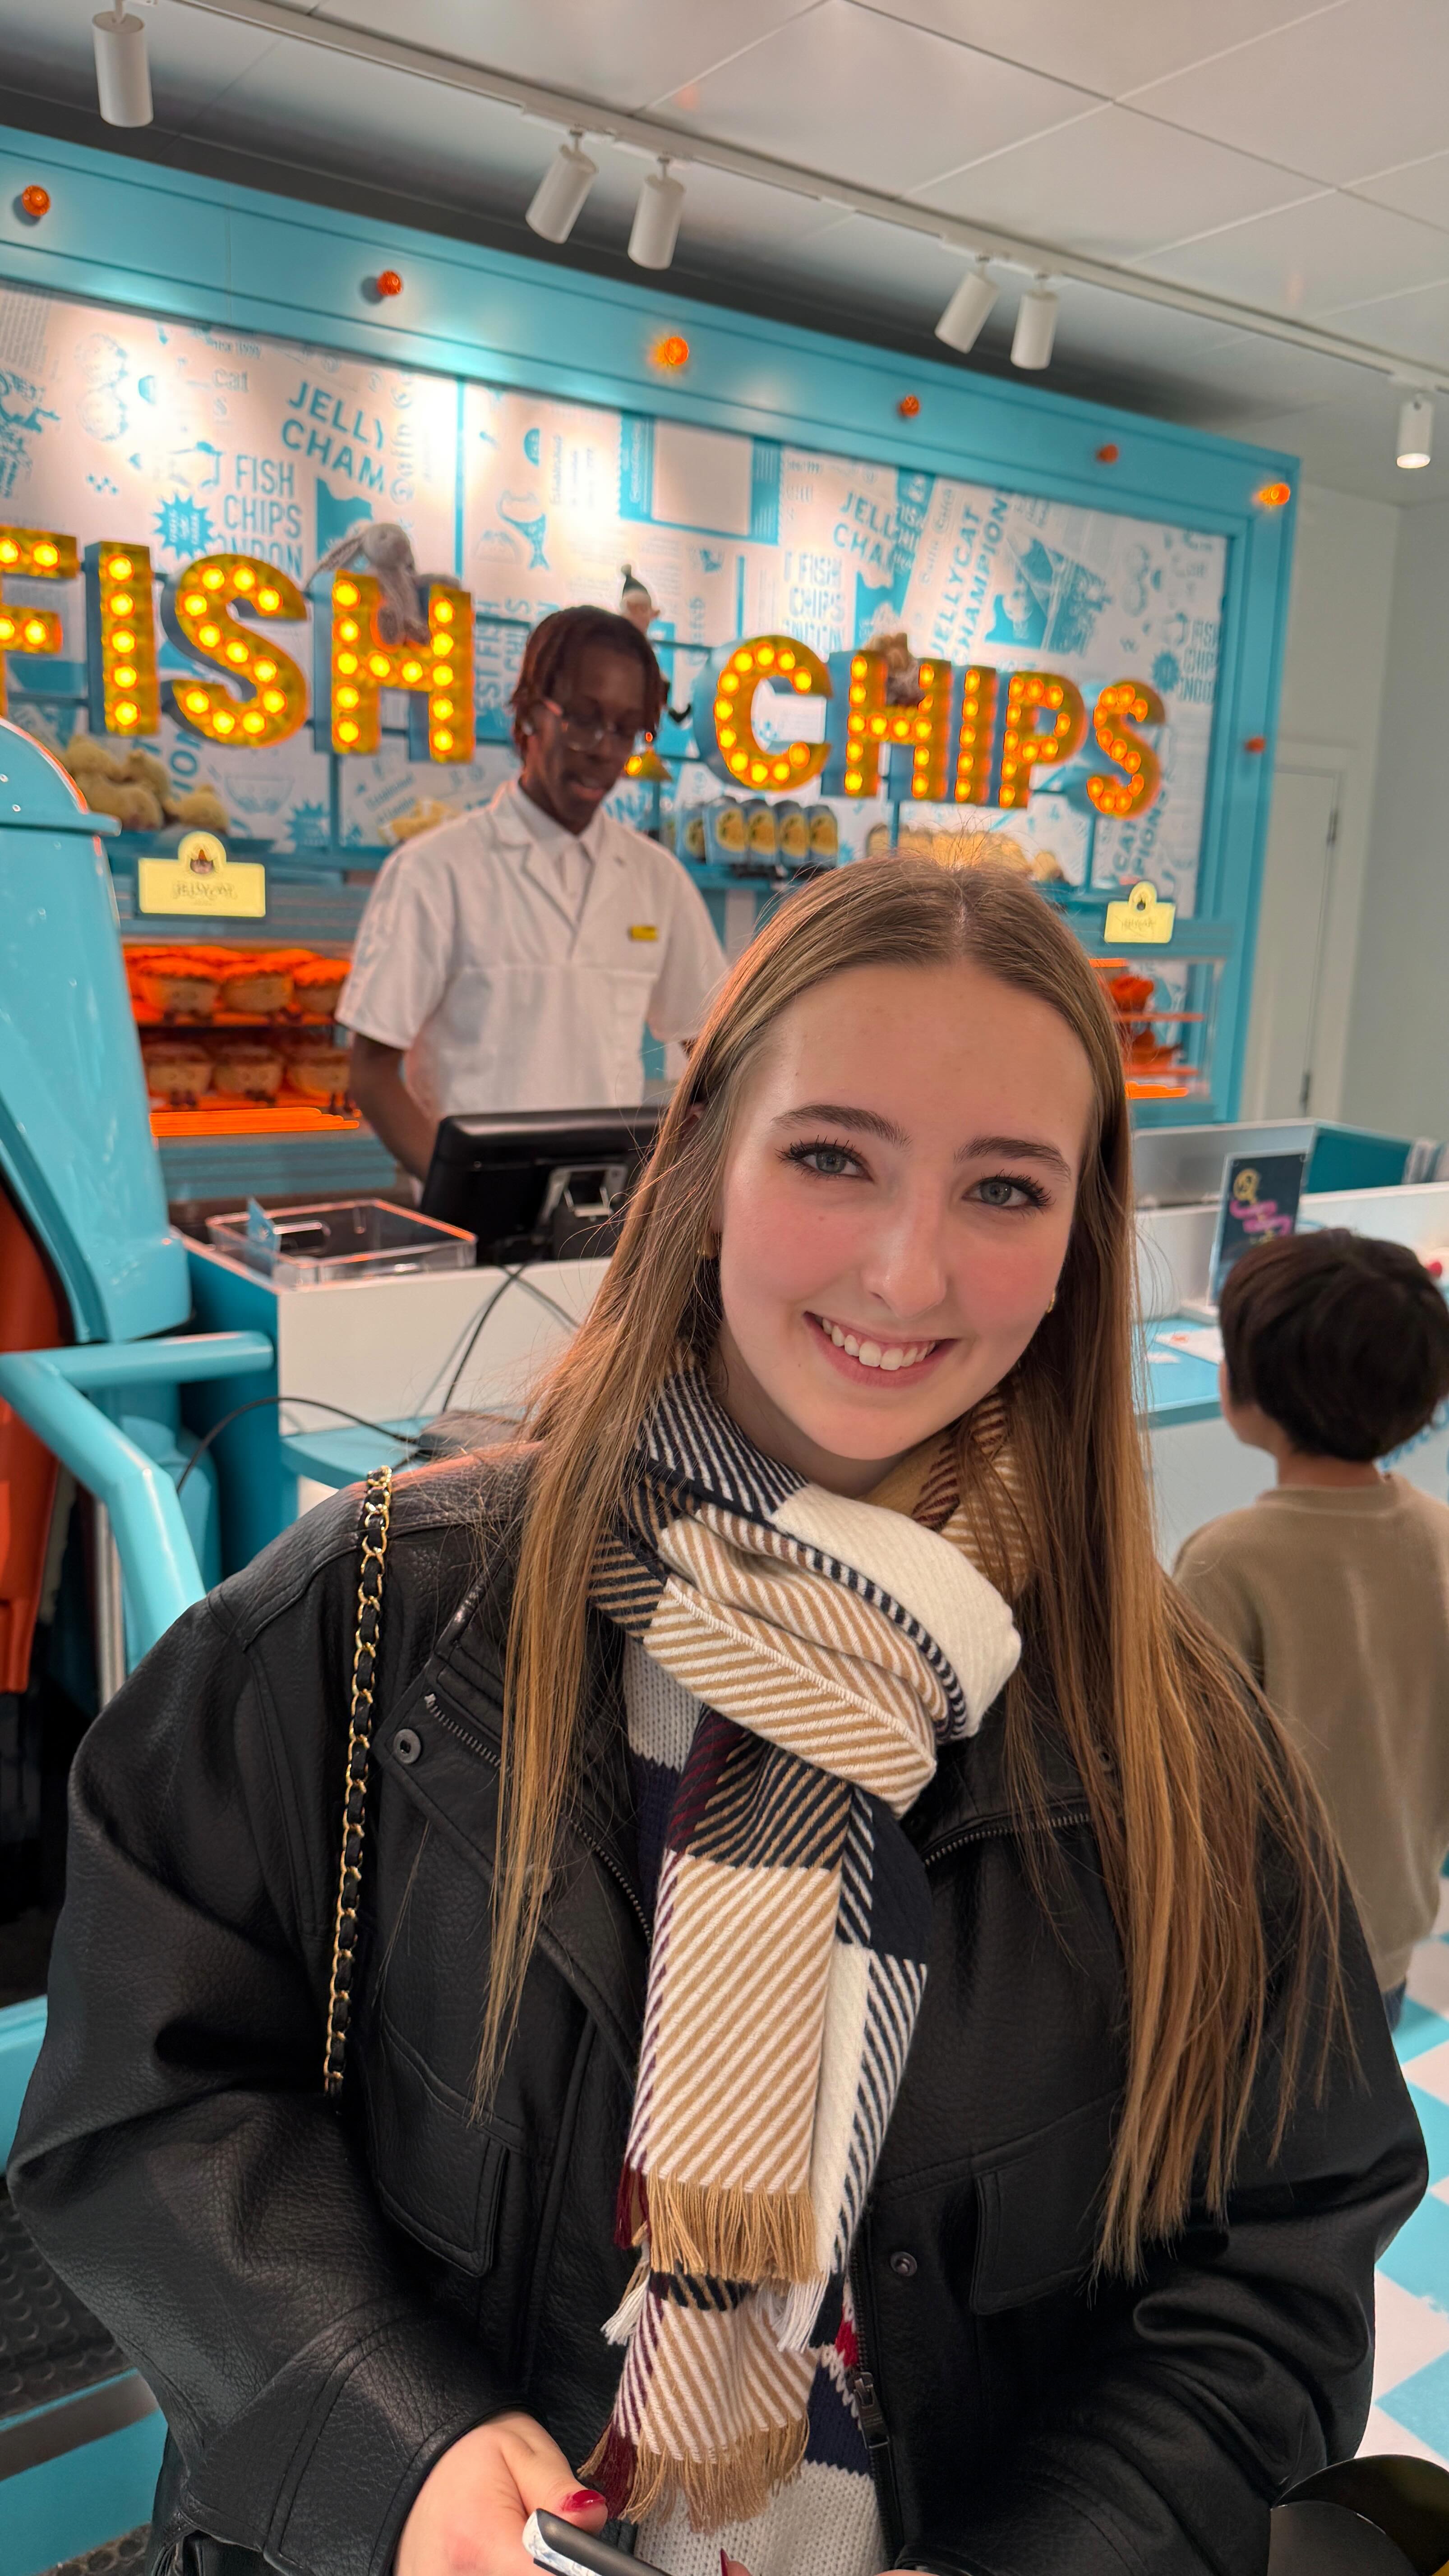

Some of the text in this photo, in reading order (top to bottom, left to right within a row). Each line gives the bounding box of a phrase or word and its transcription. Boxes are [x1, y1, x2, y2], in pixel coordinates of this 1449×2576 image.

[223, 494, 301, 539] CHIPS
[235, 453, 295, 498] FISH
[930, 504, 981, 658] JELLYCAT
[0, 524, 1168, 821] FISH CHIPS
